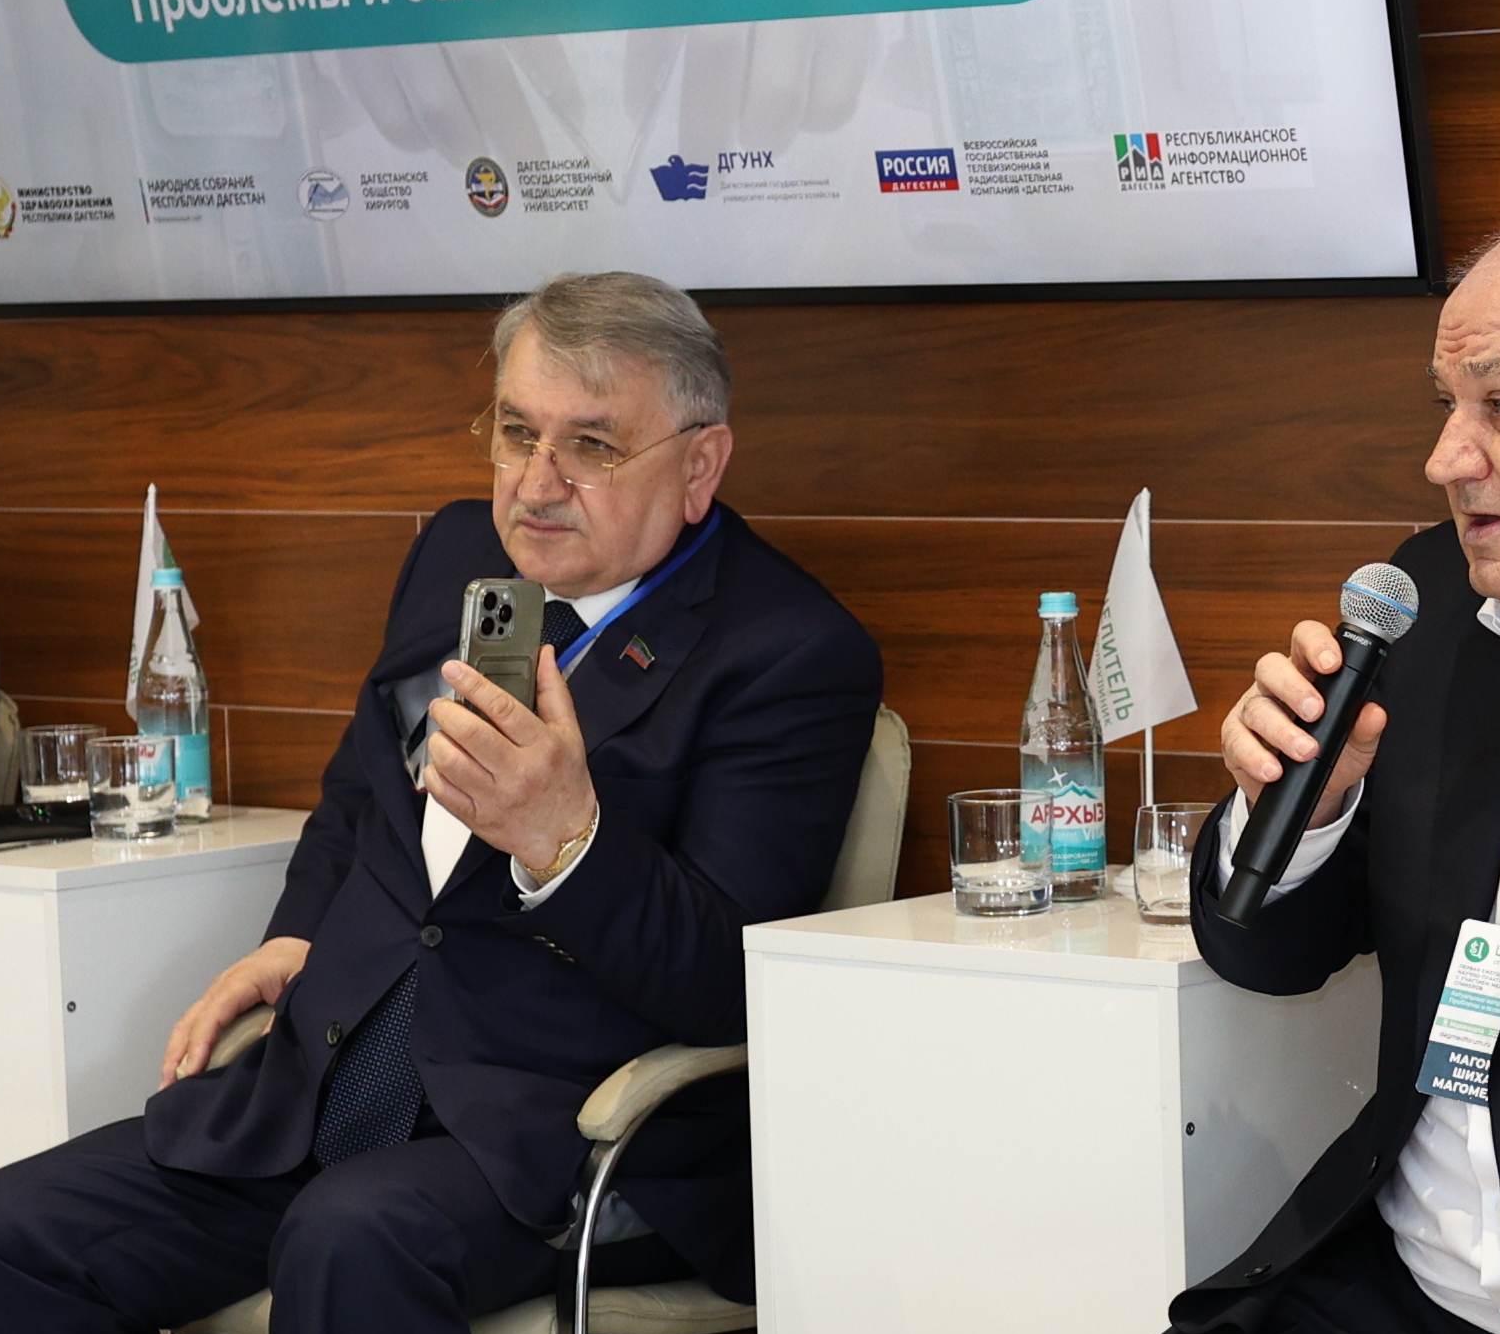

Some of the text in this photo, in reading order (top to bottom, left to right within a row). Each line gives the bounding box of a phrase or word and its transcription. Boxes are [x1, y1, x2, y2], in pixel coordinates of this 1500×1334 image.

[963, 138, 1038, 151] ВСЕРОССИЙСКАЯ
[1164, 127, 1298, 148] РЕСПУБЛИКАНСКОЕ
[717, 150, 775, 174] ДГУНХ
[965, 149, 1050, 163] ГОСУДАРСТВЕННАЯ
[1168, 147, 1308, 167] ИНФОРМАЦИОННОЕ
[516, 156, 591, 173] ДАГЕСТАНСКИЙ
[881, 154, 952, 178] РОССИЯ
[966, 162, 1042, 174] ТЕЛЕВИЗИОННАЯ
[146, 175, 256, 194] НАРОДНОЕ СОБРАНИЕ
[360, 170, 429, 186] ДАГЕСТАНСКОЕ
[518, 169, 614, 186] ГОСУДАРСТВЕННЫЙ
[968, 172, 1063, 185] РАДИОВЕЩАТЕЛЬНАЯ
[1170, 169, 1246, 186] АГЕНТСТВО
[16, 184, 93, 198] МИНИСТЕРСТВО
[520, 184, 595, 200] МЕДИЦИНСКИЙ
[891, 179, 948, 193] ДАГЕСТАН
[970, 184, 1020, 197] КОМПАНИЯ
[1121, 182, 1167, 192] ДАГЕСТАН
[150, 190, 267, 209] РЕСПУБЛИКИ ДАГЕСТАН
[522, 199, 590, 213] УНИВЕРСИТЕТ
[1101, 597, 1134, 721] ЕЛИТЕЛЬ
[1432, 1076, 1489, 1102] МАГОМЕ
